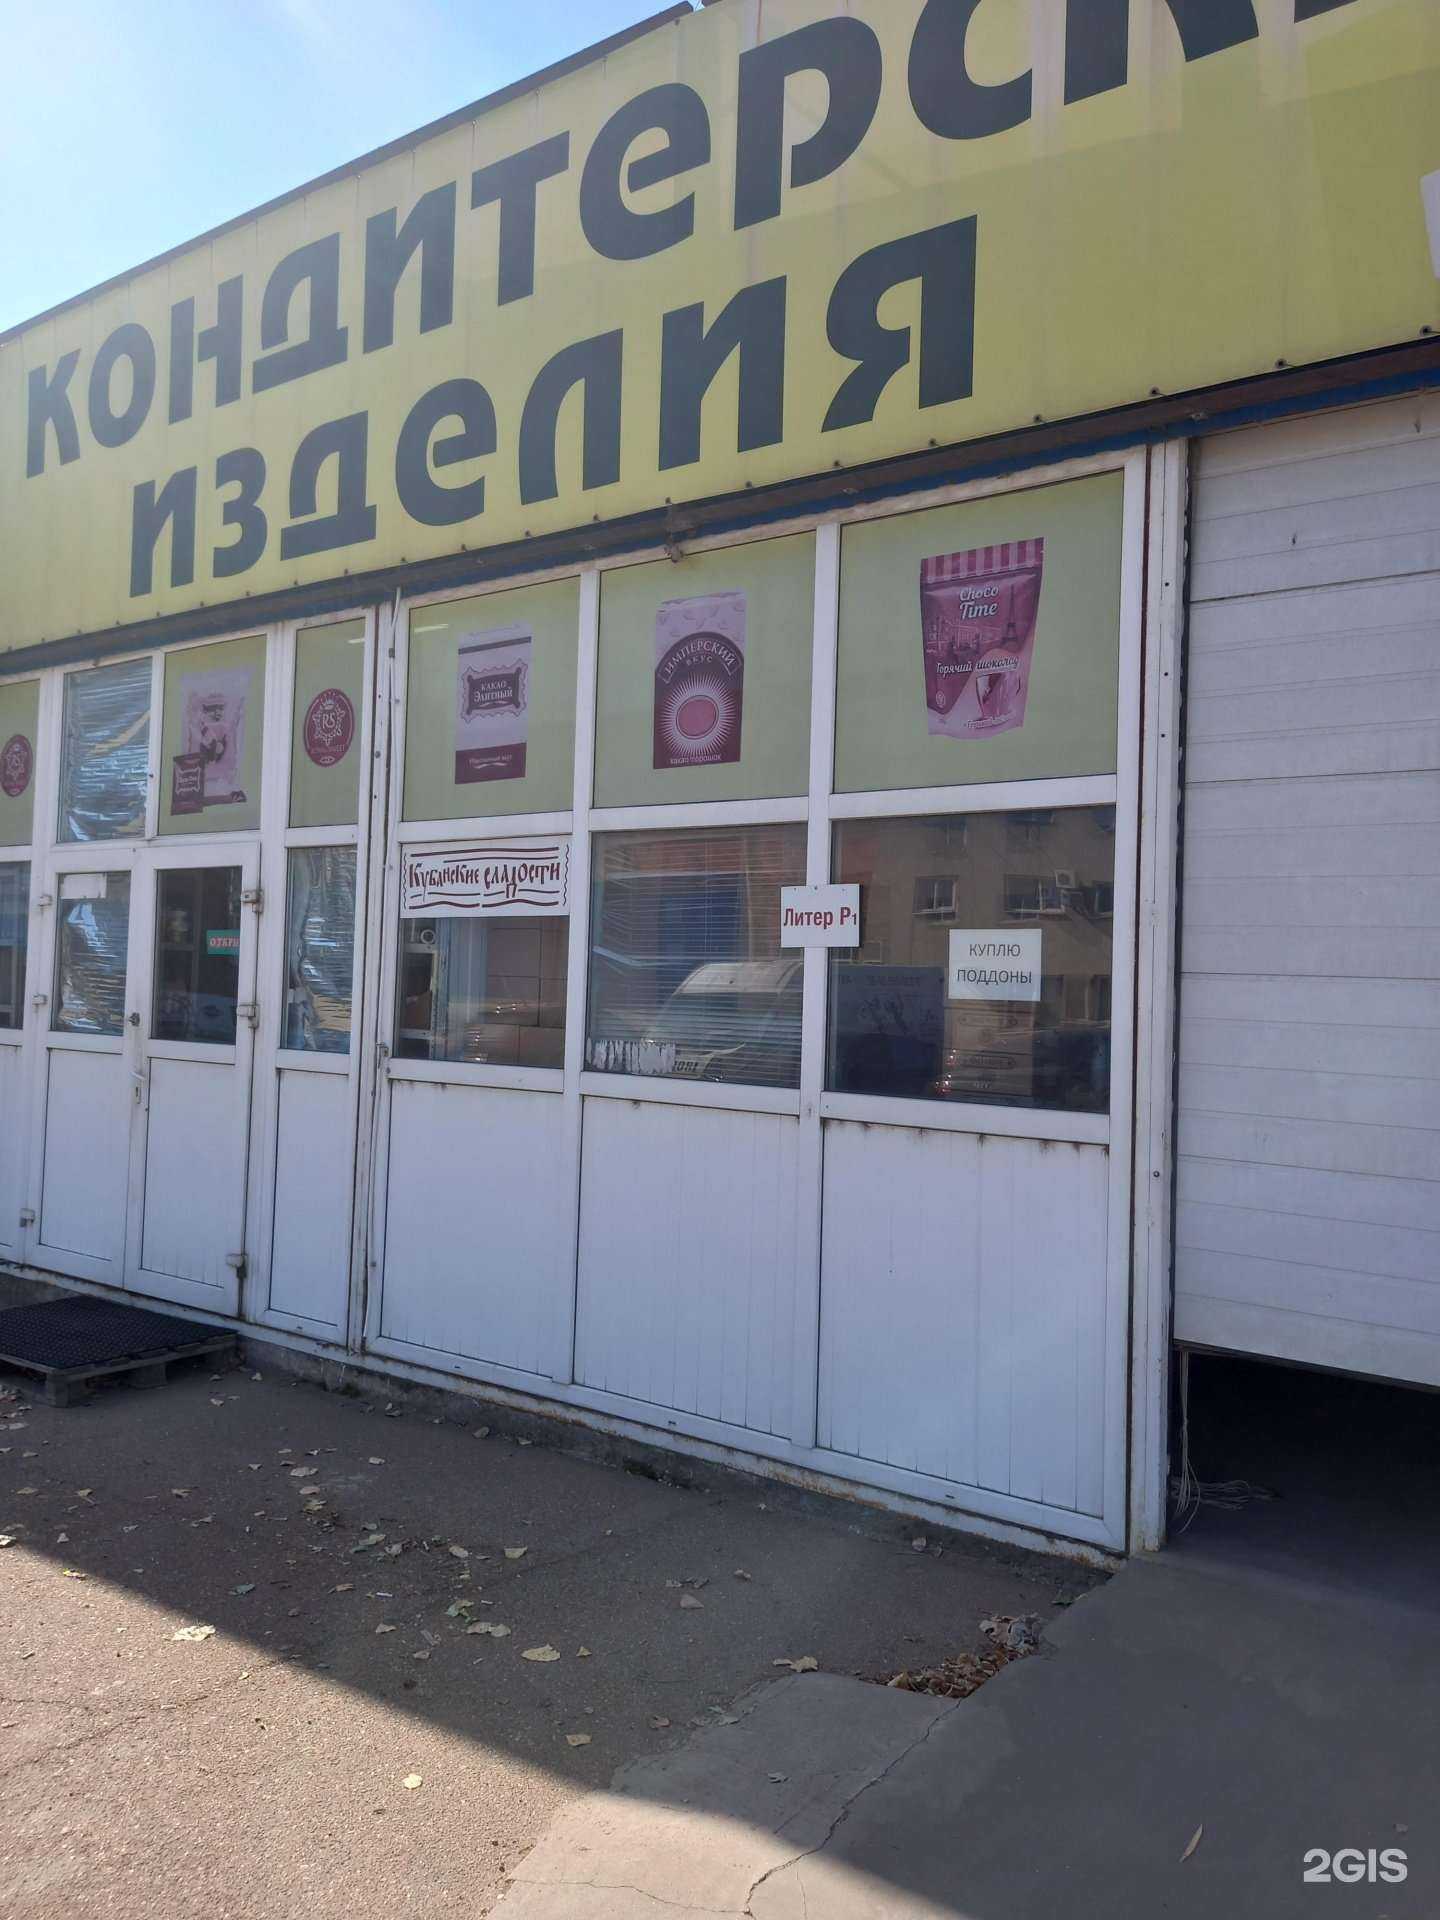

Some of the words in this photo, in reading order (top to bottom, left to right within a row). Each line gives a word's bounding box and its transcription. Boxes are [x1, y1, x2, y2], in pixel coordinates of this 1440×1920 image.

[959, 584, 999, 601] Choco
[959, 602, 998, 620] Time
[664, 639, 736, 674] ИМПЕРСКИЙ
[783, 908, 834, 930] Литер
[969, 943, 1021, 957] КУПЛЮ
[957, 968, 1032, 986] ПОДДОНЫ
